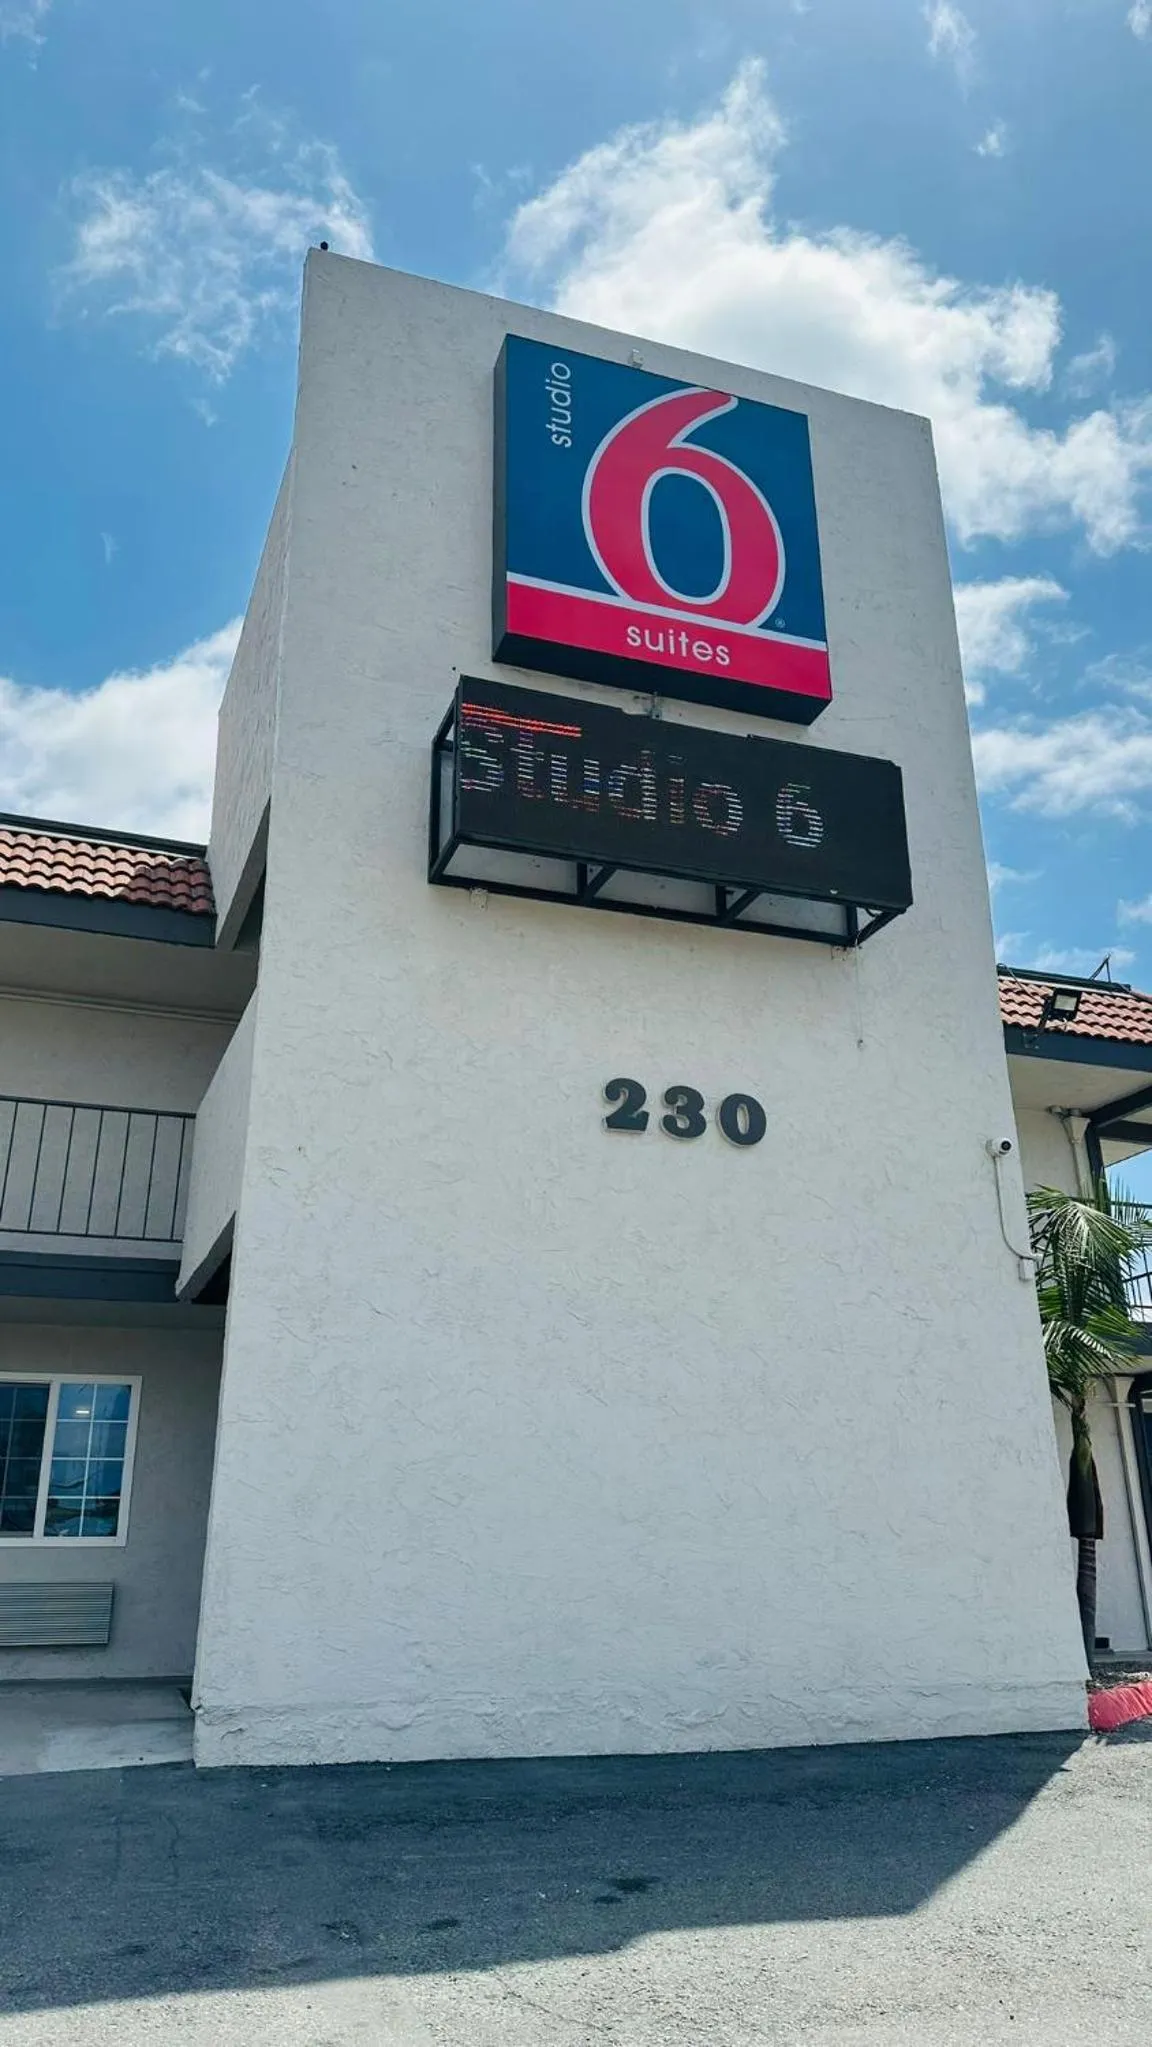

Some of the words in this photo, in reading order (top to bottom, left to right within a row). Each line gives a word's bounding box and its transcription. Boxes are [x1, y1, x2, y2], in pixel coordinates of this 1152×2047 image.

[544, 361, 572, 448] studio
[581, 386, 786, 629] 6
[626, 624, 731, 666] suites
[775, 782, 825, 848] 6
[604, 1077, 767, 1146] 230
